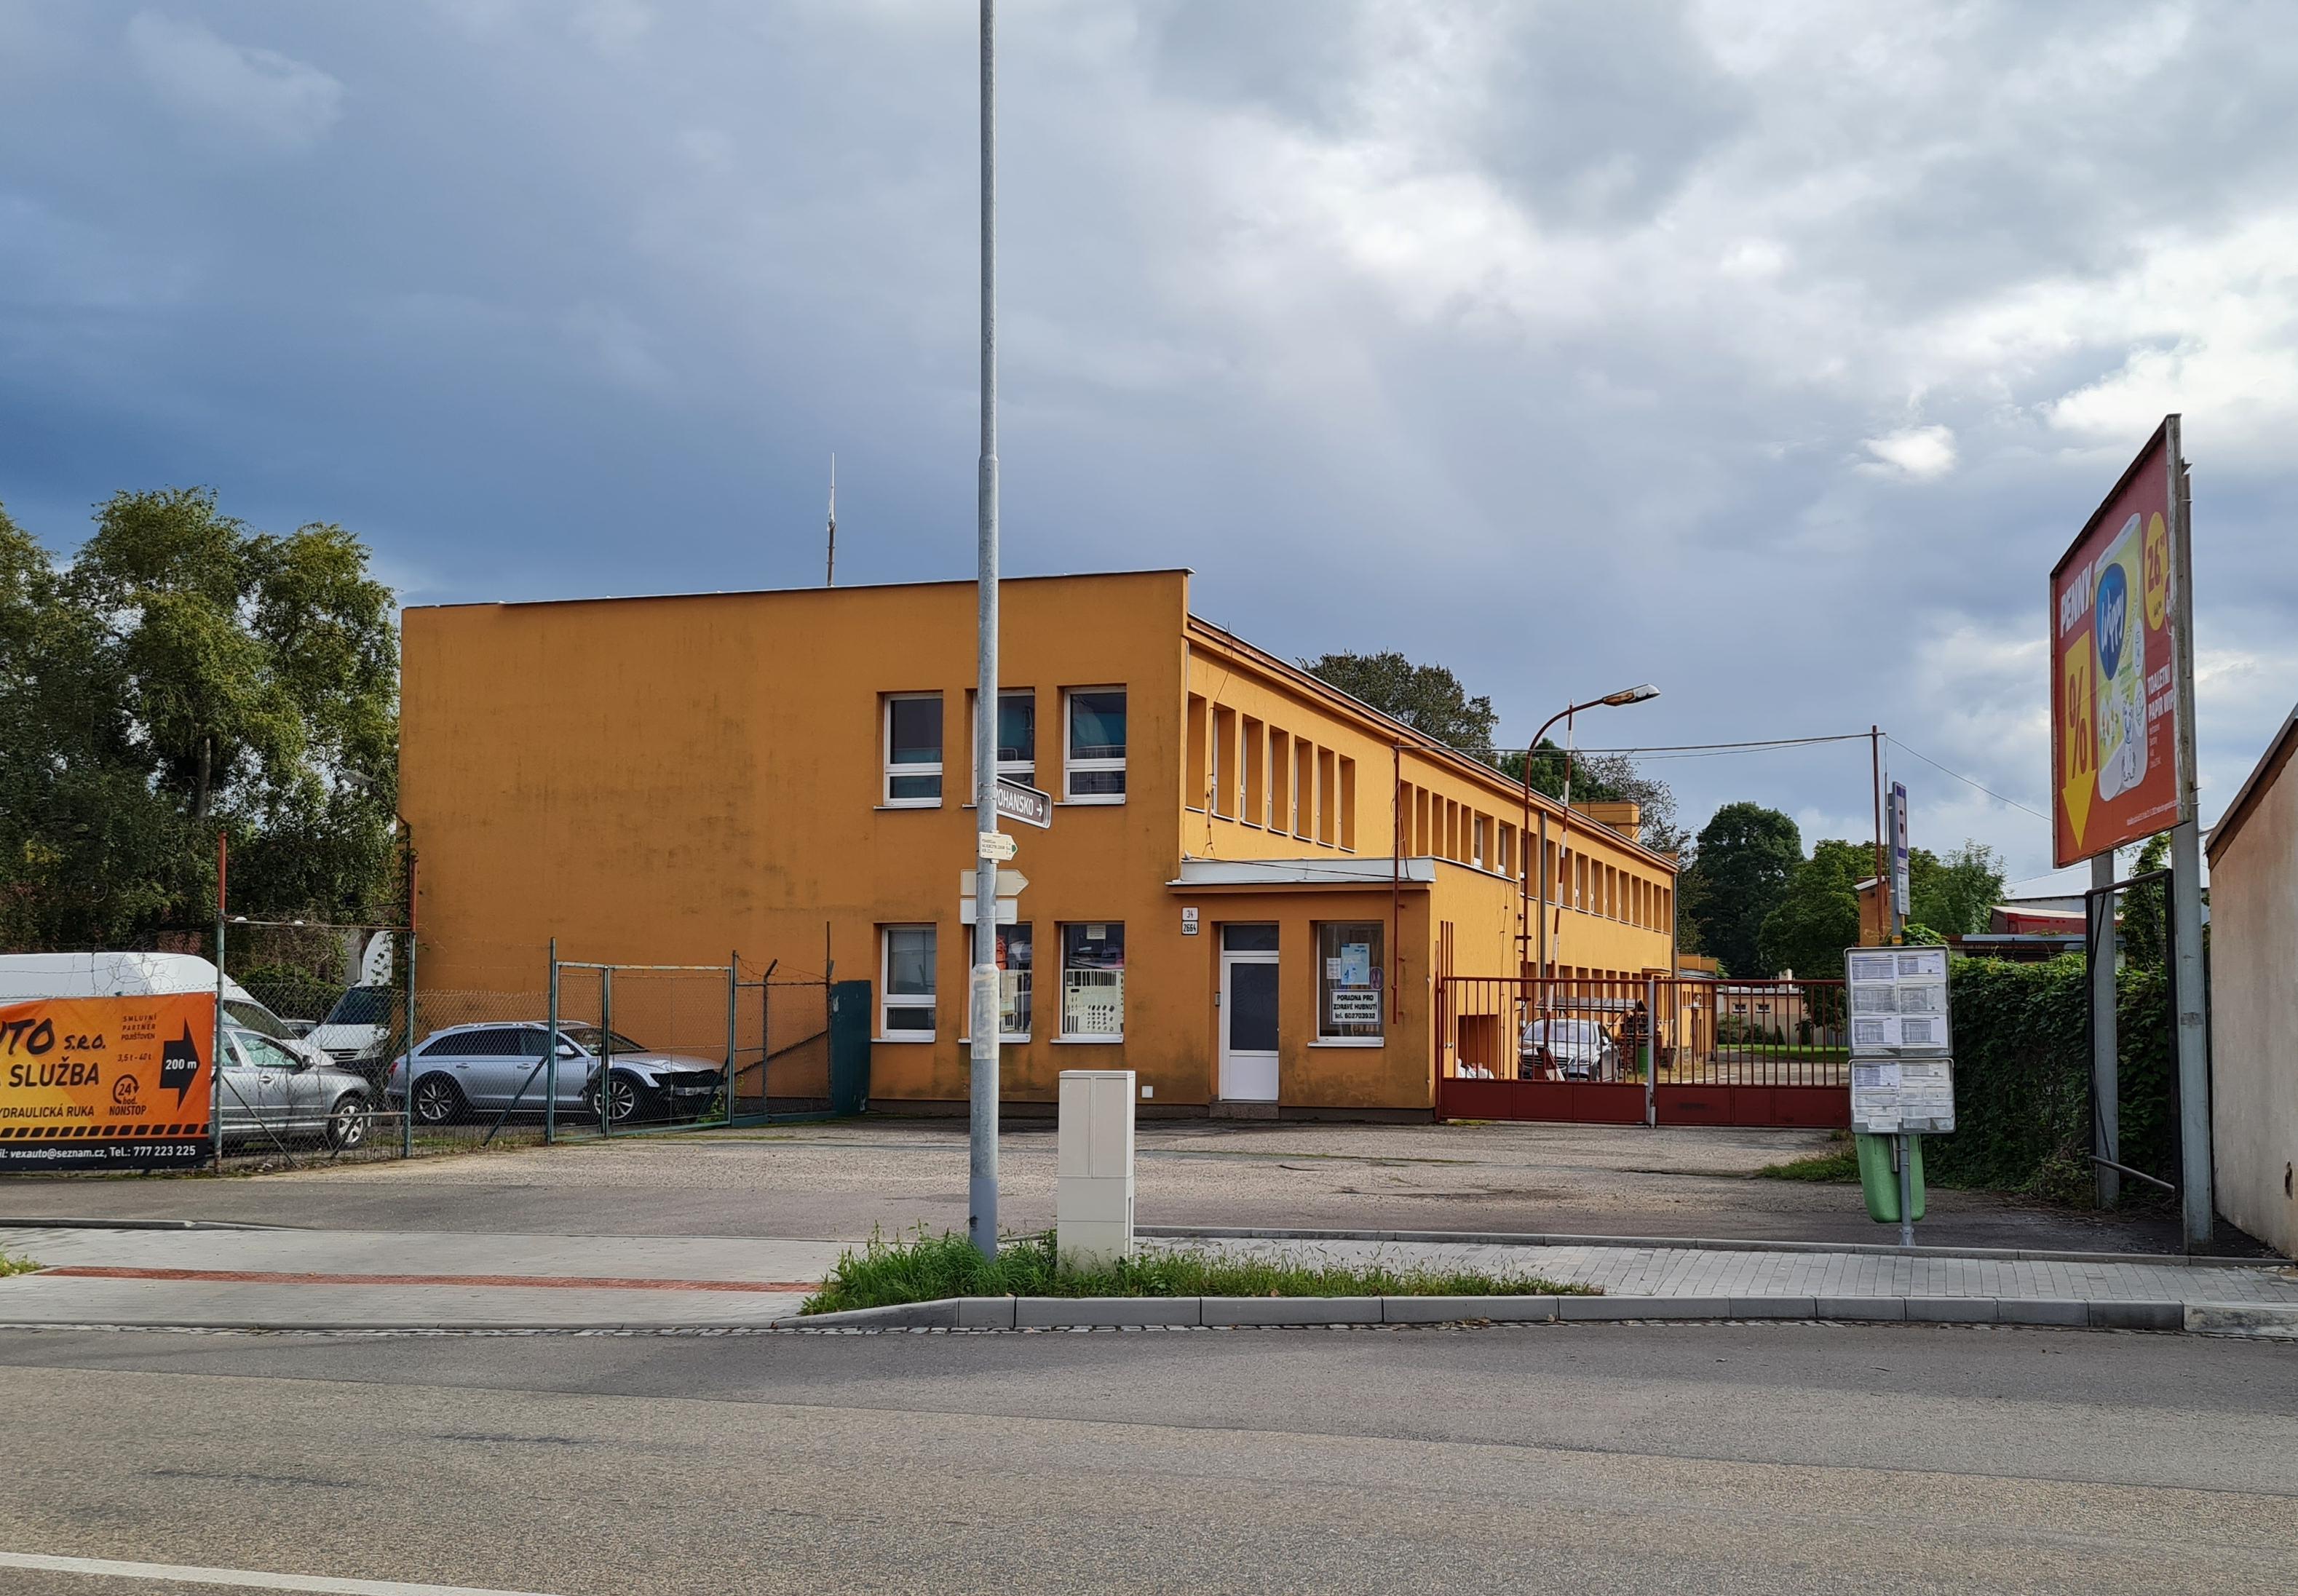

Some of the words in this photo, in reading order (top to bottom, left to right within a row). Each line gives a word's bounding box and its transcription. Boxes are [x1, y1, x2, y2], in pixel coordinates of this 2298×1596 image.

[2147, 656, 2171, 696] TOALETNÍ
[2148, 691, 2164, 723] PAPÍR
[1184, 924, 1196, 932] 2664
[123, 1013, 156, 1023] SMLUVNÍ
[122, 1023, 156, 1031] PARTNER
[117, 1053, 129, 1063] 3,5
[165, 1059, 185, 1071] 200
[187, 1060, 197, 1070] m
[9, 1056, 100, 1087] SLUŽBA
[118, 1083, 132, 1096] 24
[66, 1105, 95, 1117] RUKA
[109, 1105, 147, 1116] NONSTOP
[109, 1146, 131, 1157] Tel.:
[133, 1146, 152, 1156] 777
[154, 1146, 173, 1156] 223
[175, 1145, 197, 1156] 225
